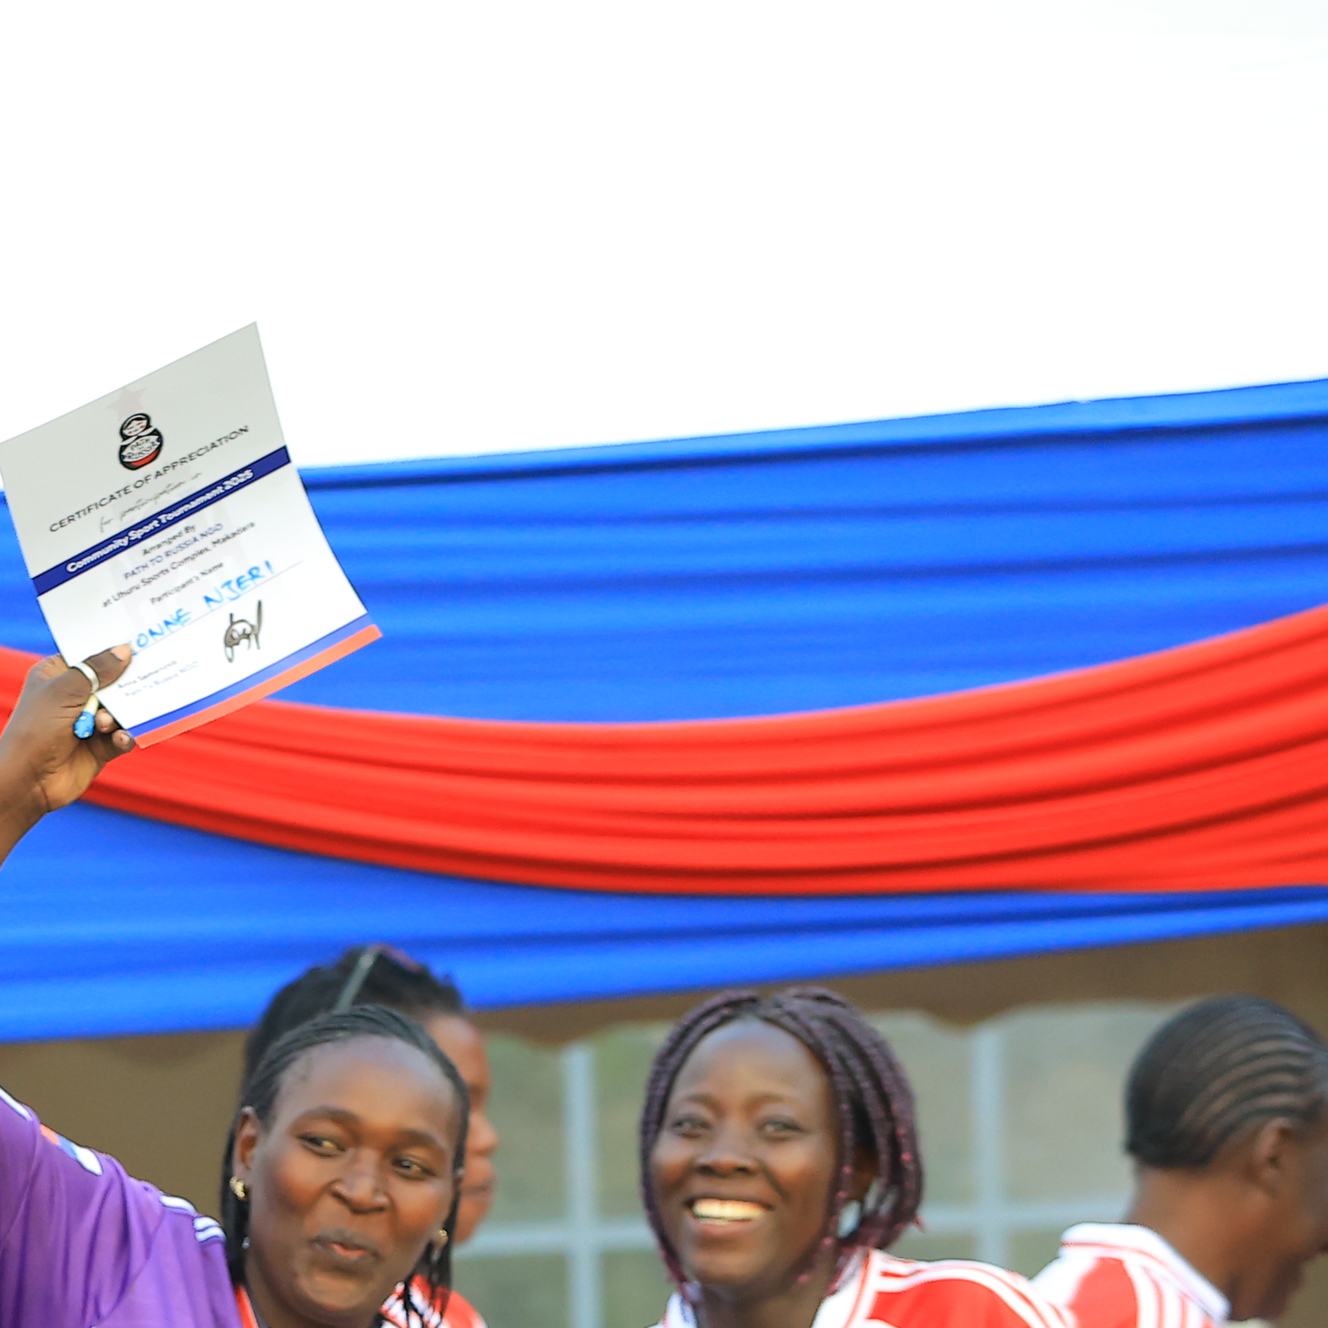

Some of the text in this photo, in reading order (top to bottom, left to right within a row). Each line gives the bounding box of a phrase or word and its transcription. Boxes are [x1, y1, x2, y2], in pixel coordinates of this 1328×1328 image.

[49, 425, 249, 533] CERTIFICATE OF APPRECIATION
[66, 535, 130, 573] Community
[128, 520, 160, 543] Sport
[159, 484, 225, 525] Tournament
